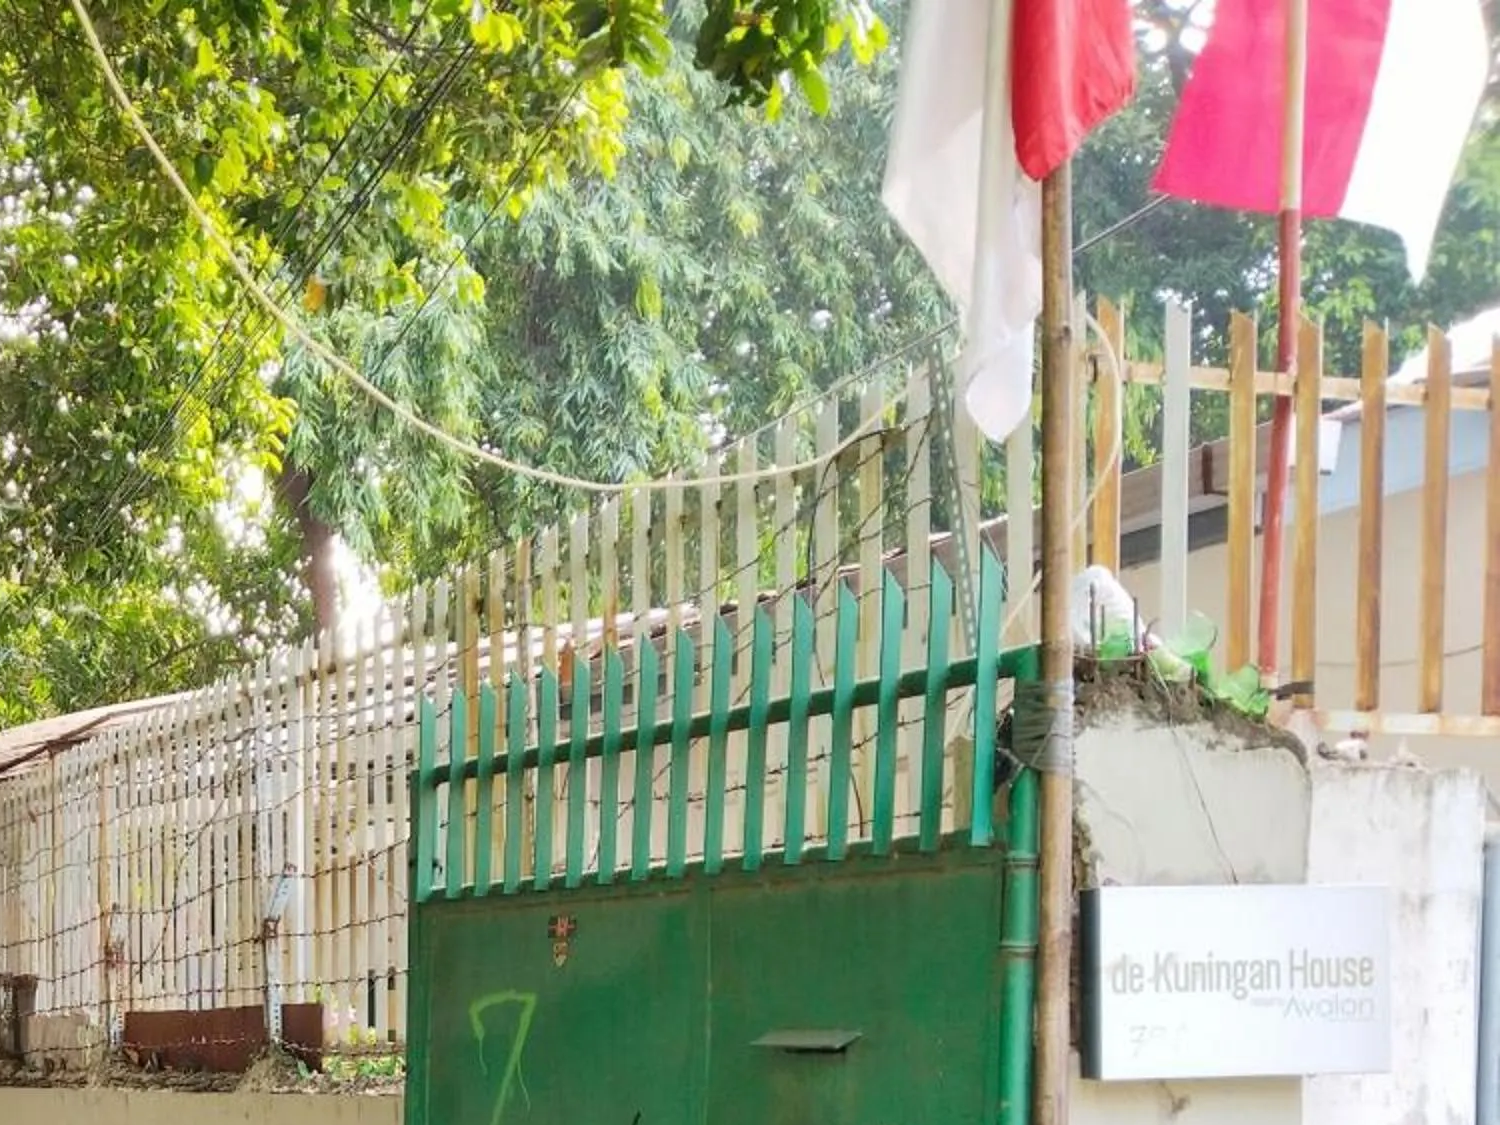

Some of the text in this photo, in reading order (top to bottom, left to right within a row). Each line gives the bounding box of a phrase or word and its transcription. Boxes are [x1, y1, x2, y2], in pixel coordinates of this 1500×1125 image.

[1111, 947, 1375, 1001] de Kuningan House
[1283, 991, 1376, 1019] Avalon
